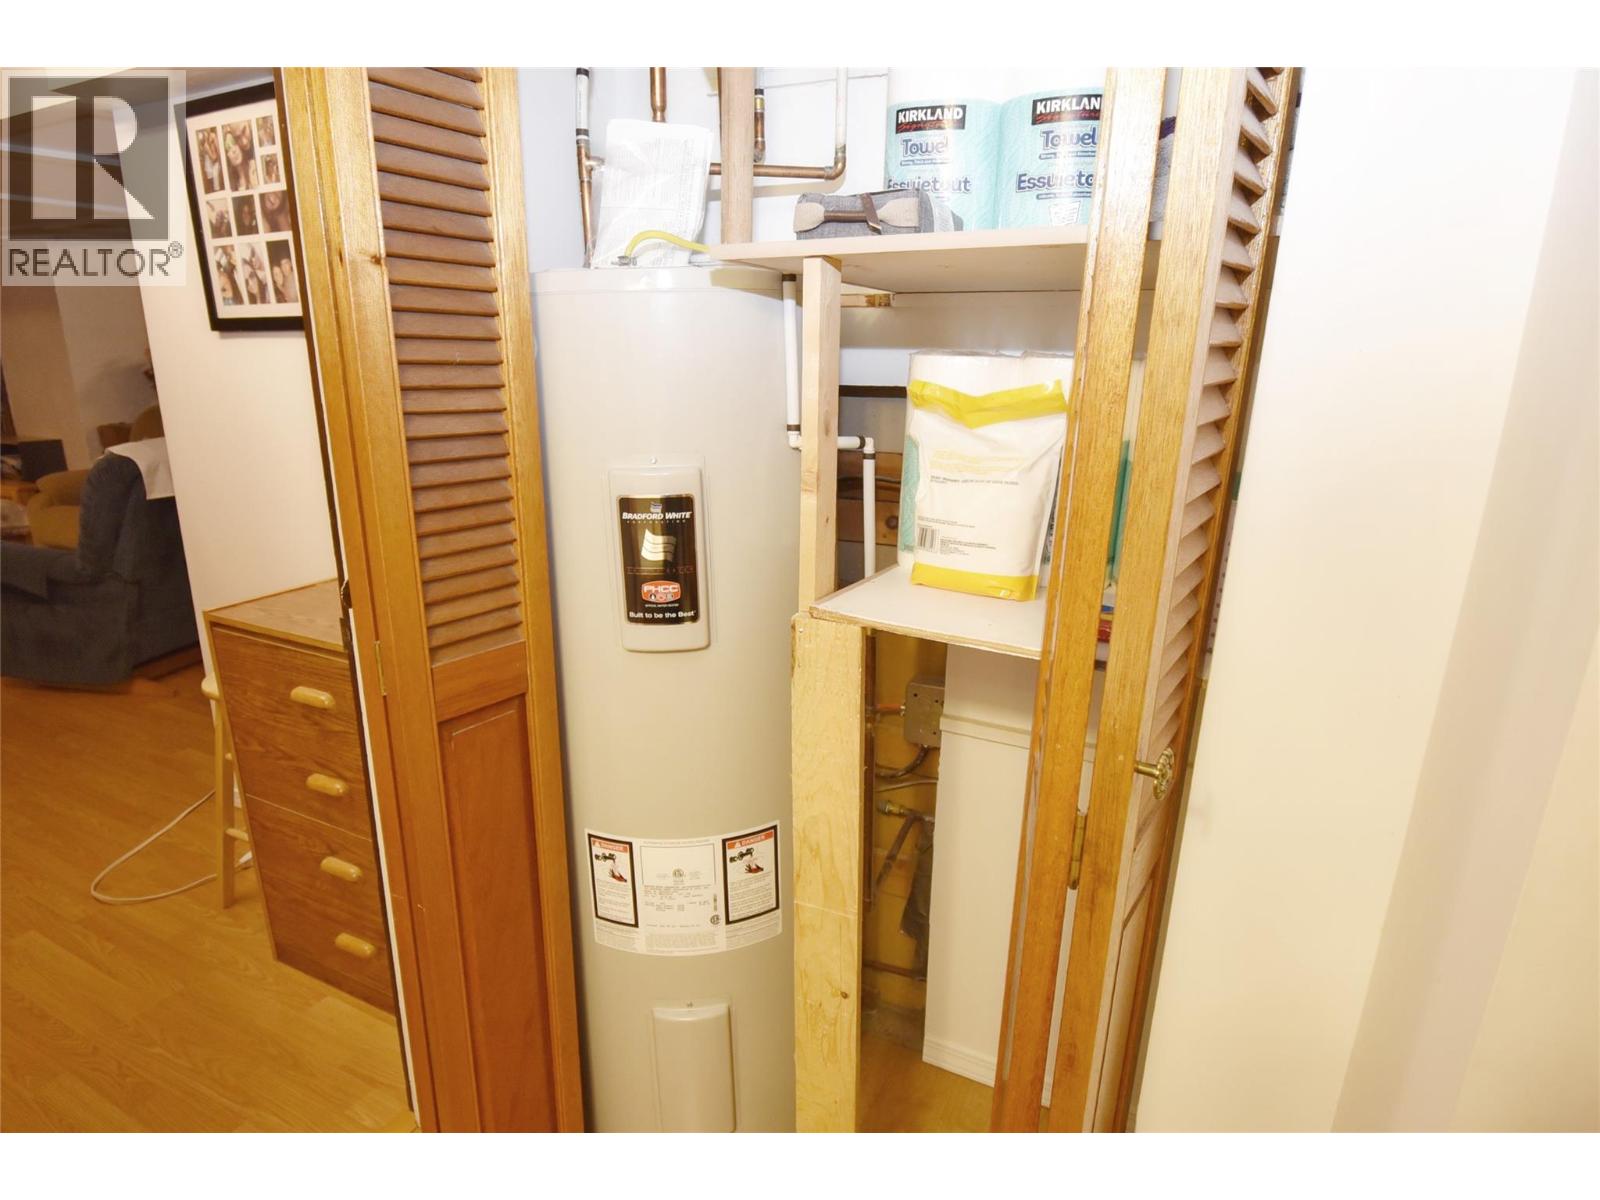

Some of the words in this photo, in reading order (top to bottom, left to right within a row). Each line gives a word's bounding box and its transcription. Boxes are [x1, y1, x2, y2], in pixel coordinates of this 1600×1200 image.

[1036, 96, 1101, 115] KIRKLAN
[898, 107, 964, 124] KIRKLAND
[902, 136, 949, 156] Towel
[1041, 127, 1098, 150] Towel
[888, 177, 972, 192] Eietut
[1017, 169, 1094, 191] Essuieto
[622, 512, 664, 520] BRADFORD
[665, 511, 692, 519] WHITE
[643, 585, 679, 593] PHCC
